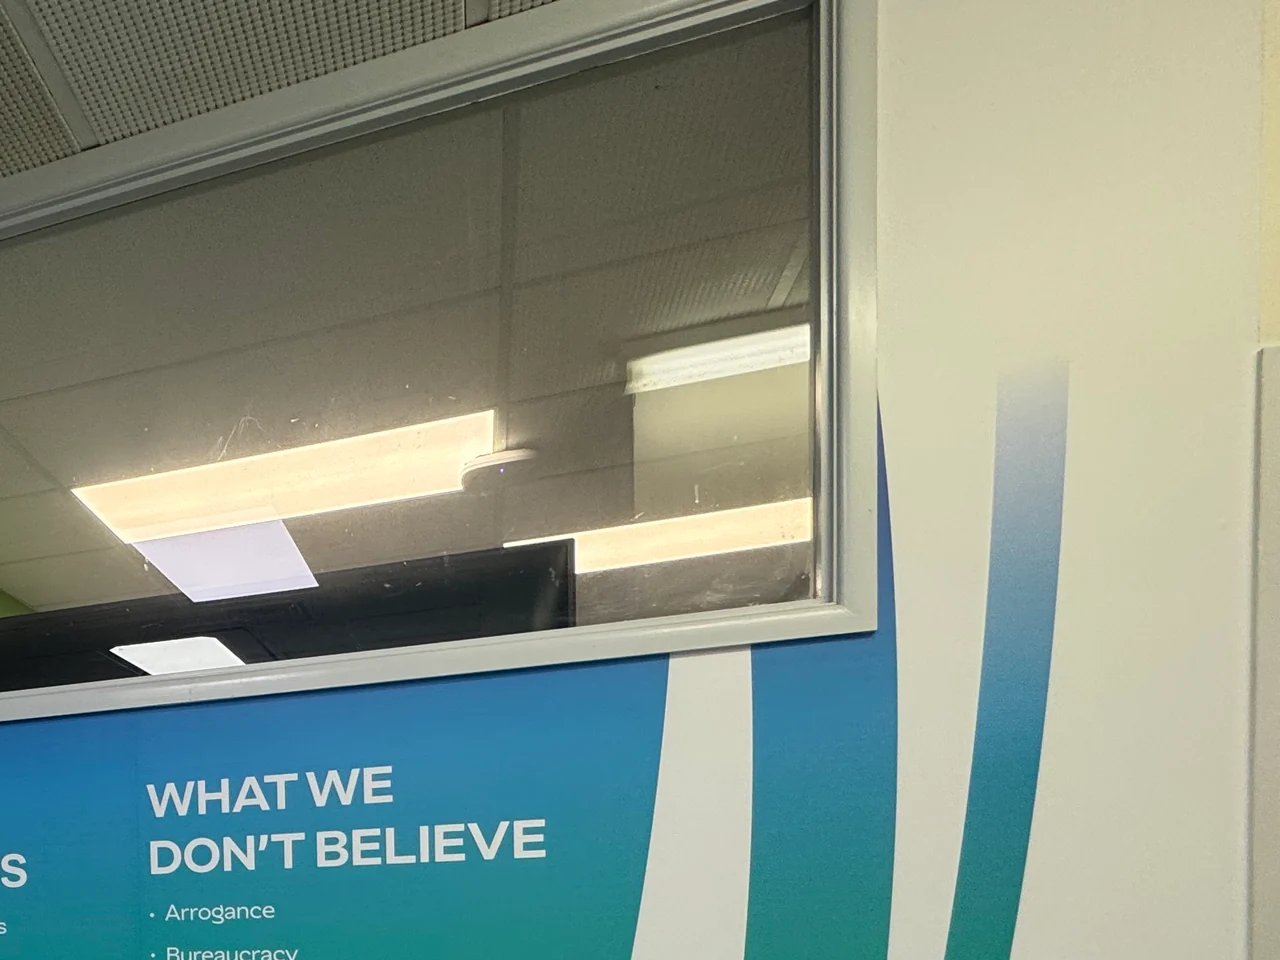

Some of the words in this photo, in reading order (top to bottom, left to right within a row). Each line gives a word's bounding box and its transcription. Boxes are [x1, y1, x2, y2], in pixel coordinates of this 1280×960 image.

[146, 773, 298, 818] WHAT
[305, 765, 393, 807] WE
[316, 819, 546, 867] BELIEVE
[165, 904, 275, 924] Arrogance
